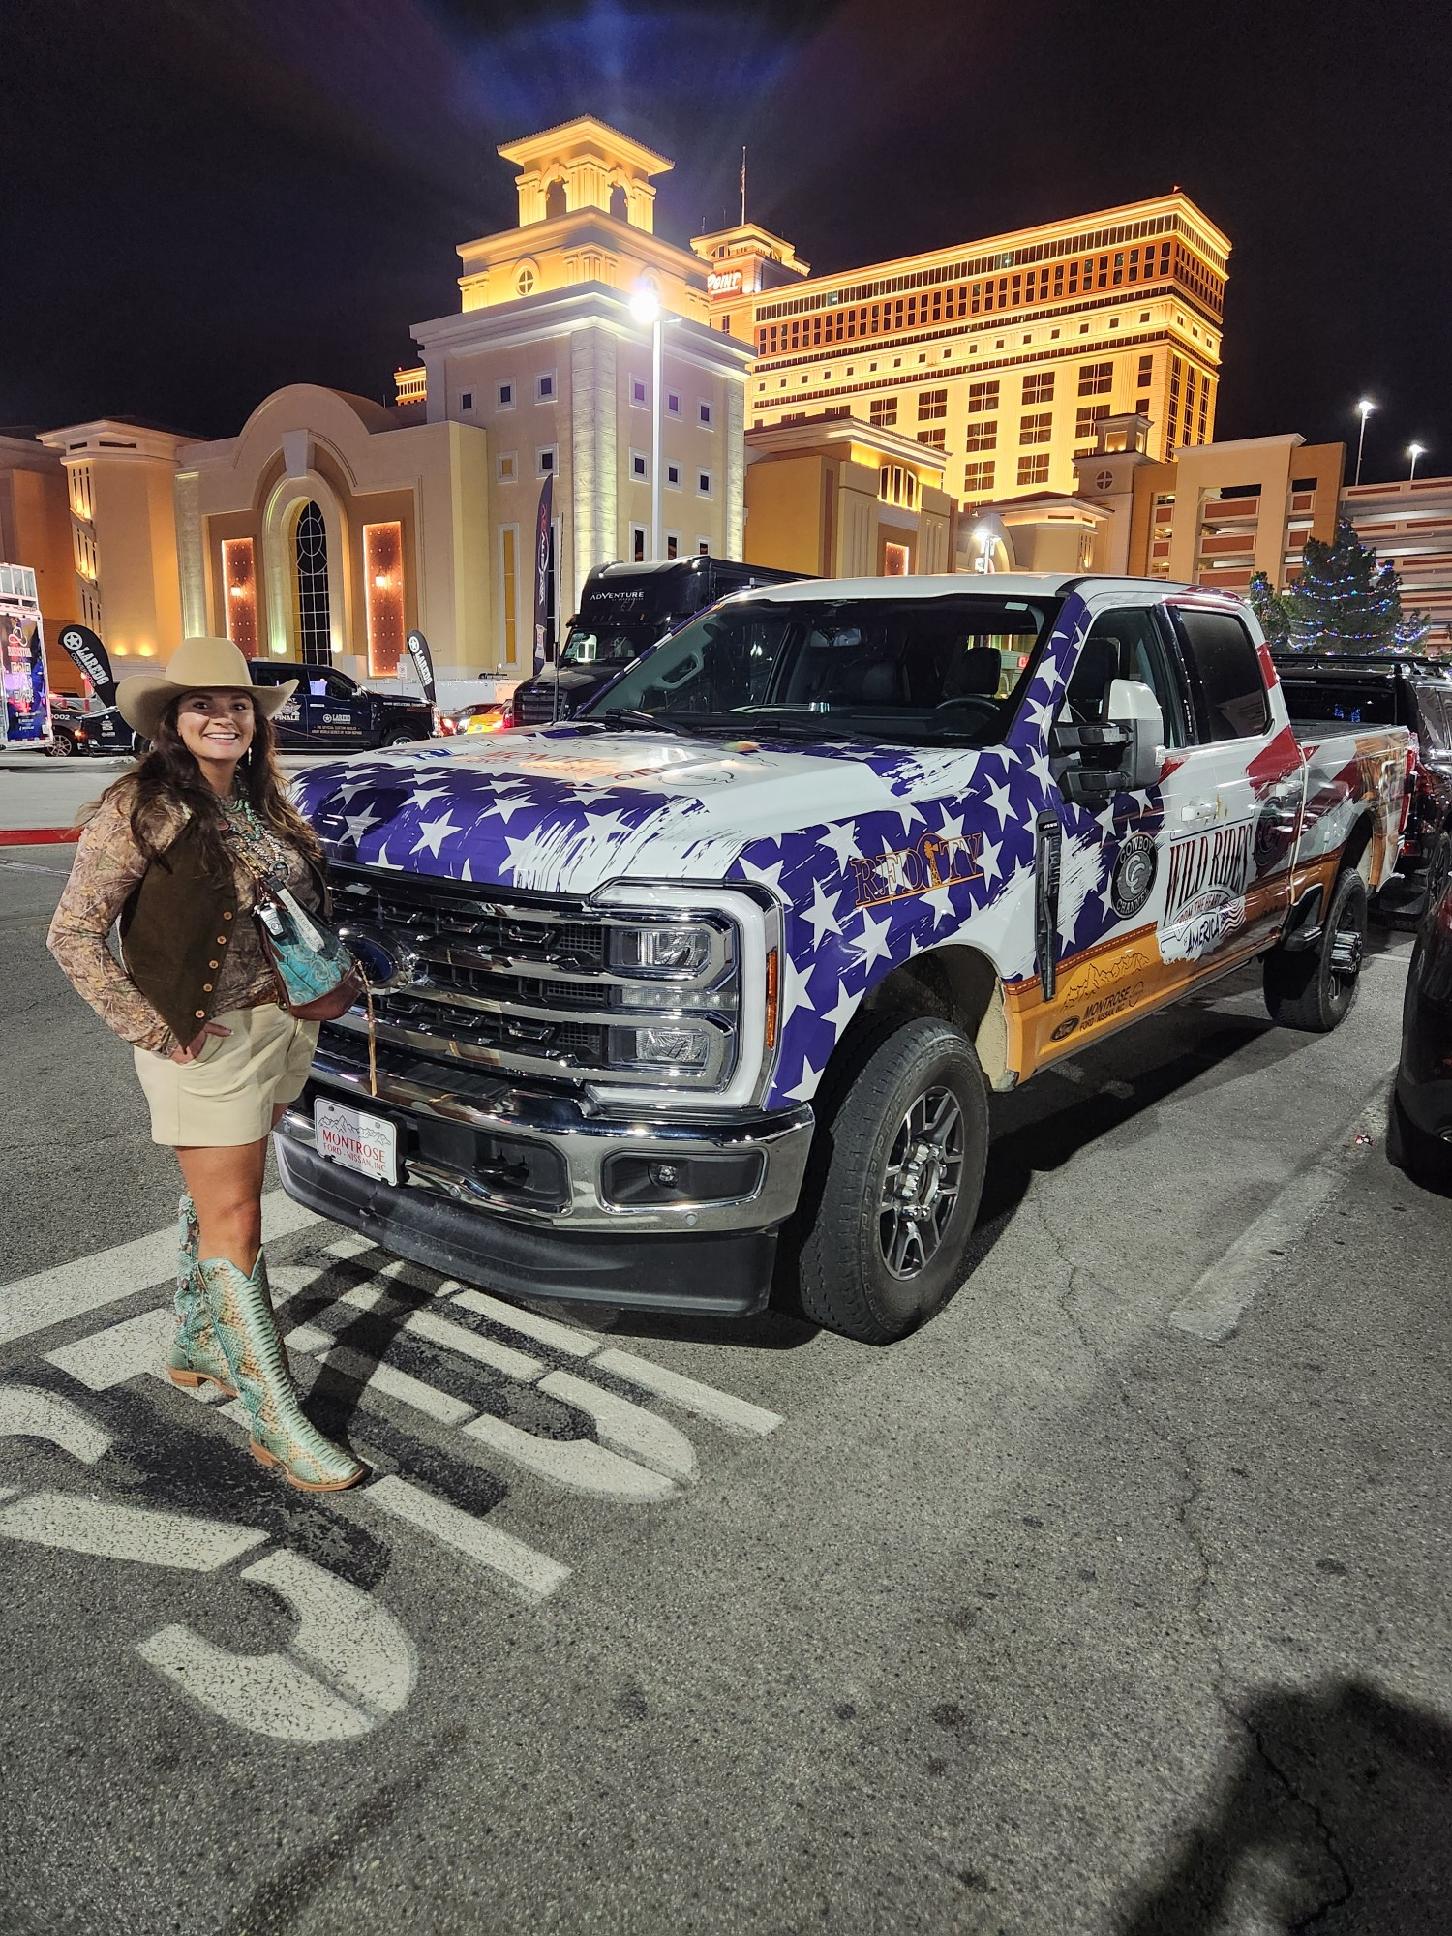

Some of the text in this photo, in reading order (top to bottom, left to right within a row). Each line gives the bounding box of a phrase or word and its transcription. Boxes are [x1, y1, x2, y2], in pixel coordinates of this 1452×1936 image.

[589, 592, 645, 601] ADVENTURE
[75, 646, 110, 685] LAREDO
[415, 649, 433, 686] LAREDO
[51, 713, 71, 721] 002
[938, 832, 983, 882] TV
[1119, 836, 1154, 864] COWBOY
[1163, 823, 1253, 927] WILD RIDES
[1186, 914, 1220, 957] AMERICA
[1083, 986, 1132, 1019] MONTROSE
[1079, 1018, 1095, 1032] FORD
[322, 1129, 386, 1164] MONTROSE
[323, 1142, 342, 1156] FORD
